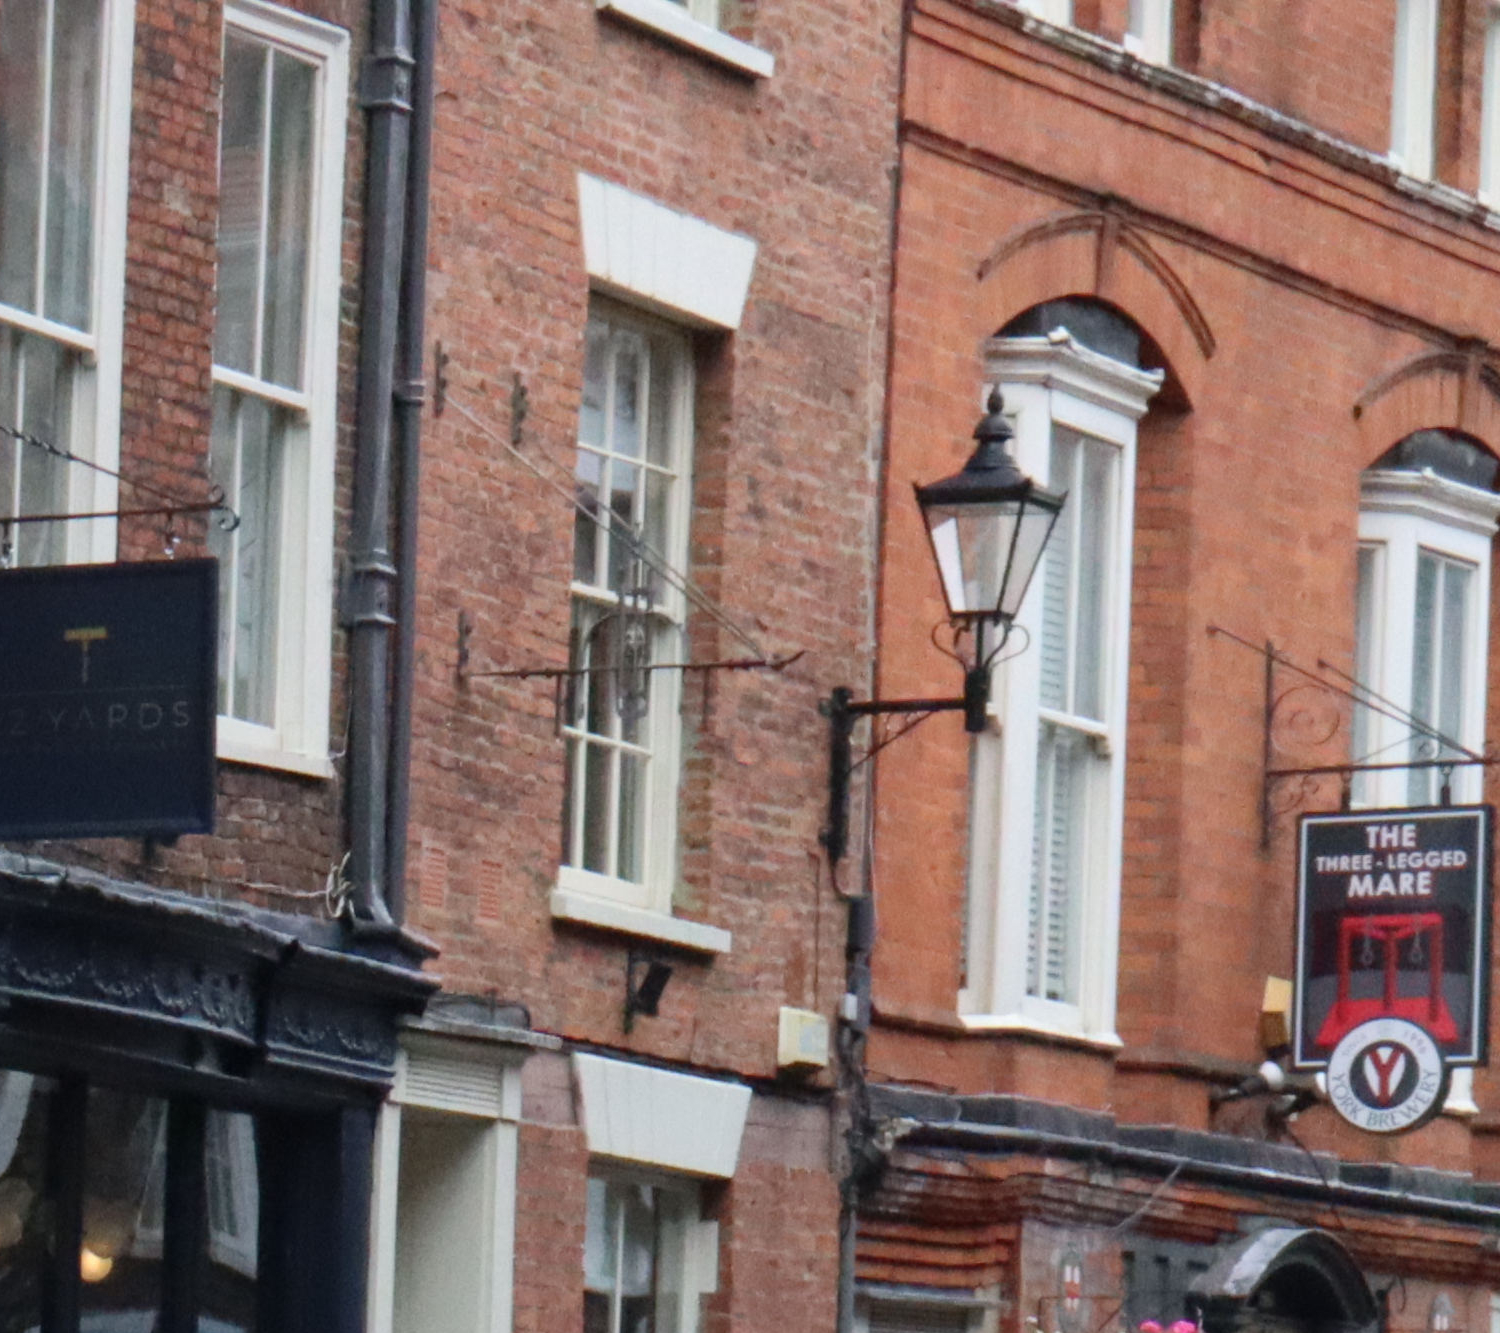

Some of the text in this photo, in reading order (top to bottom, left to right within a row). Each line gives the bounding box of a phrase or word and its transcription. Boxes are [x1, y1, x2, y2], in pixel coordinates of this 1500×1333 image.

[48, 701, 190, 730] YARDS
[1366, 824, 1418, 849] THE
[1347, 871, 1432, 898] MARE
[1331, 1068, 1438, 1128] YORK BREWERY
